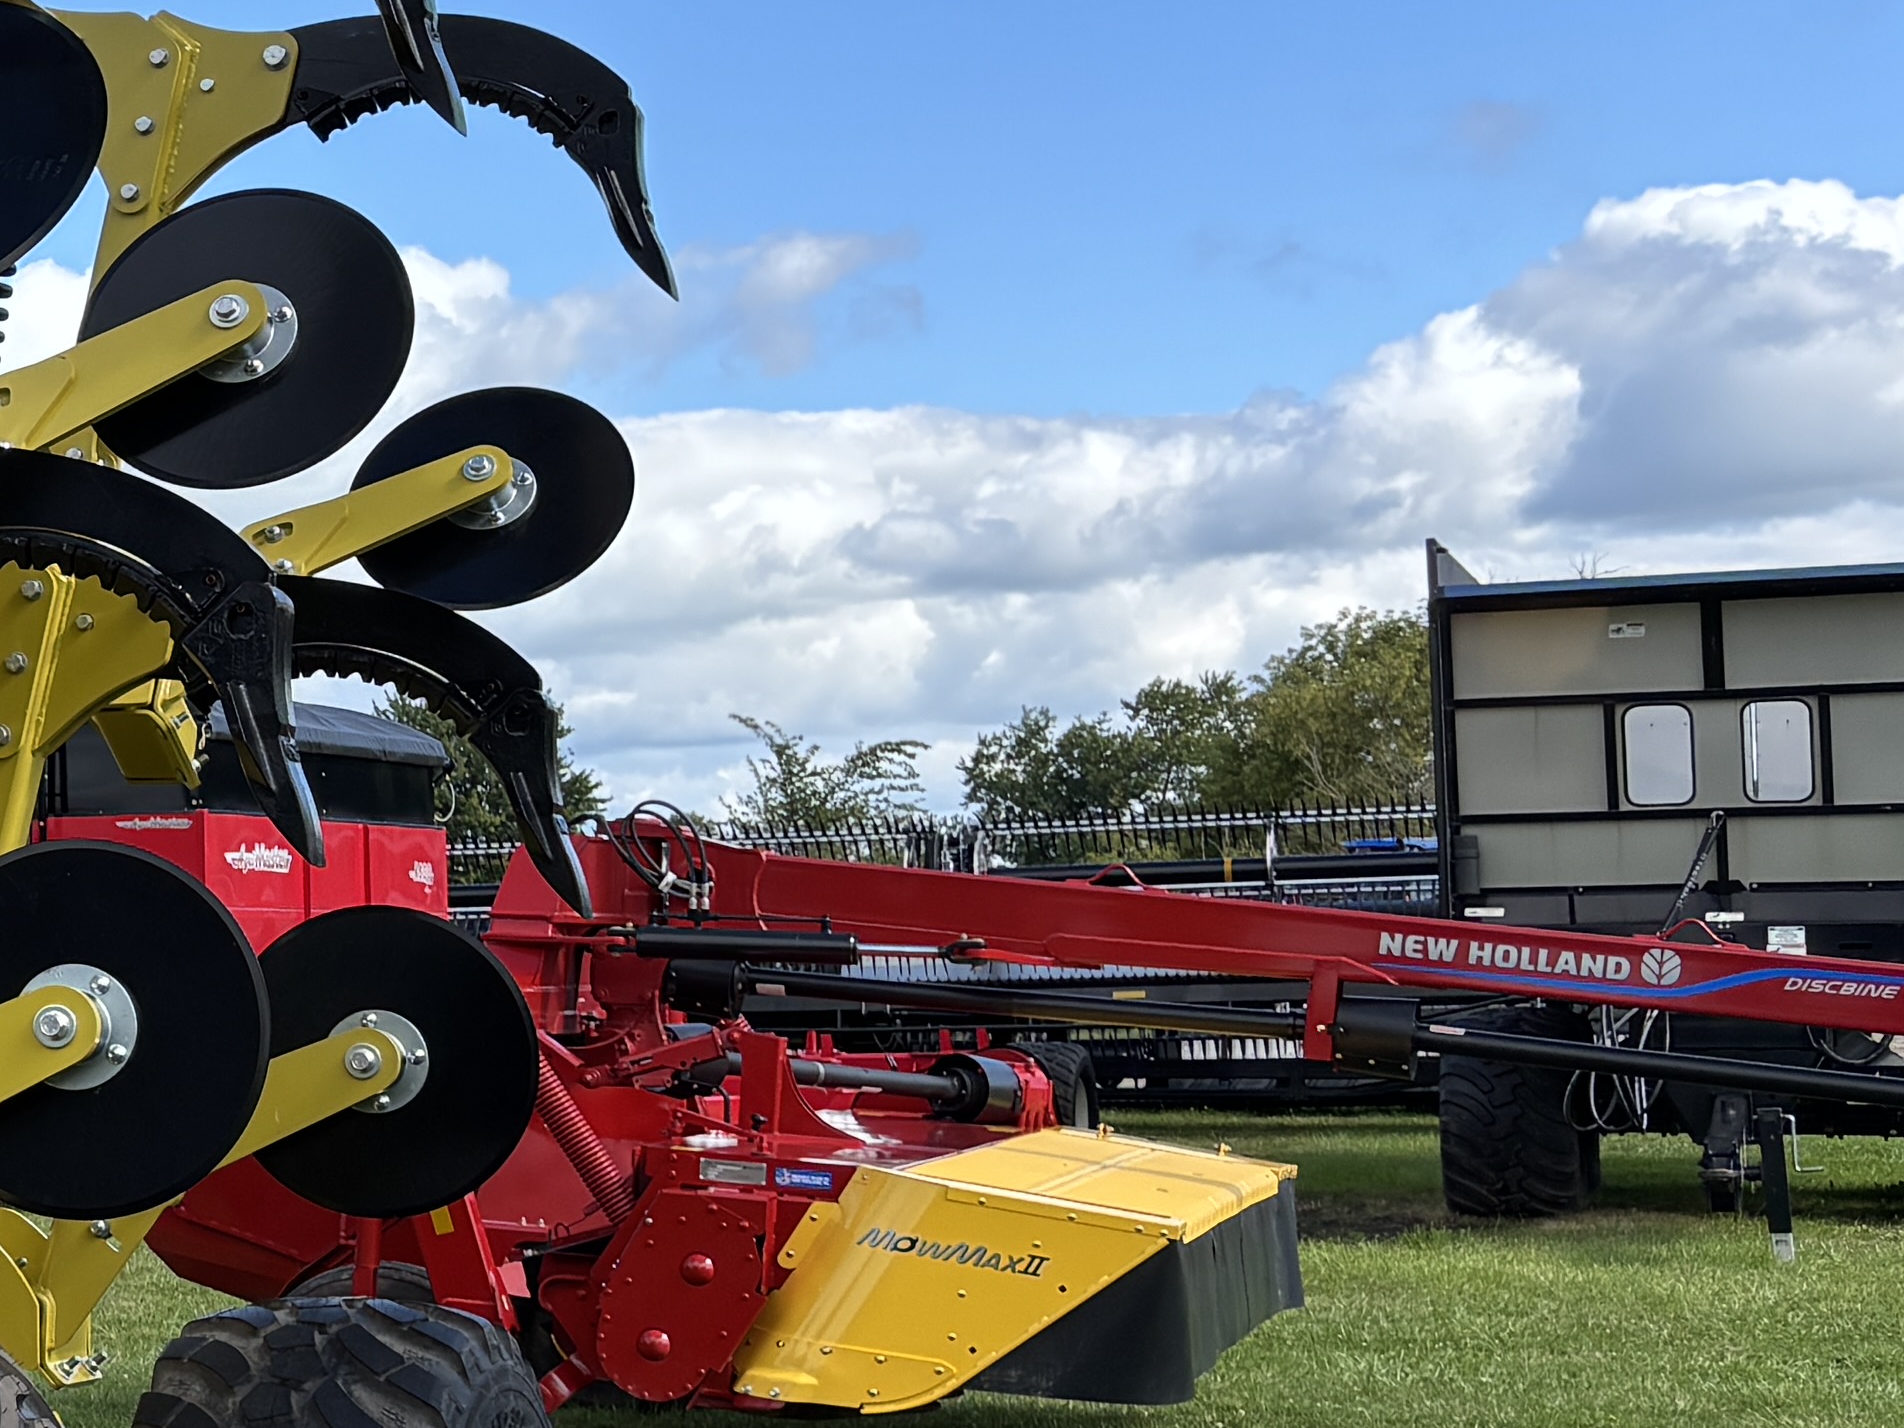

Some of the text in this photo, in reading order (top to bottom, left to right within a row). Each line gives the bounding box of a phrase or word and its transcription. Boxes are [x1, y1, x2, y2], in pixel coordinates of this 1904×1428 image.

[1378, 931, 1631, 981] NEW HOLLAND
[1784, 976, 1901, 999] DISCBINE
